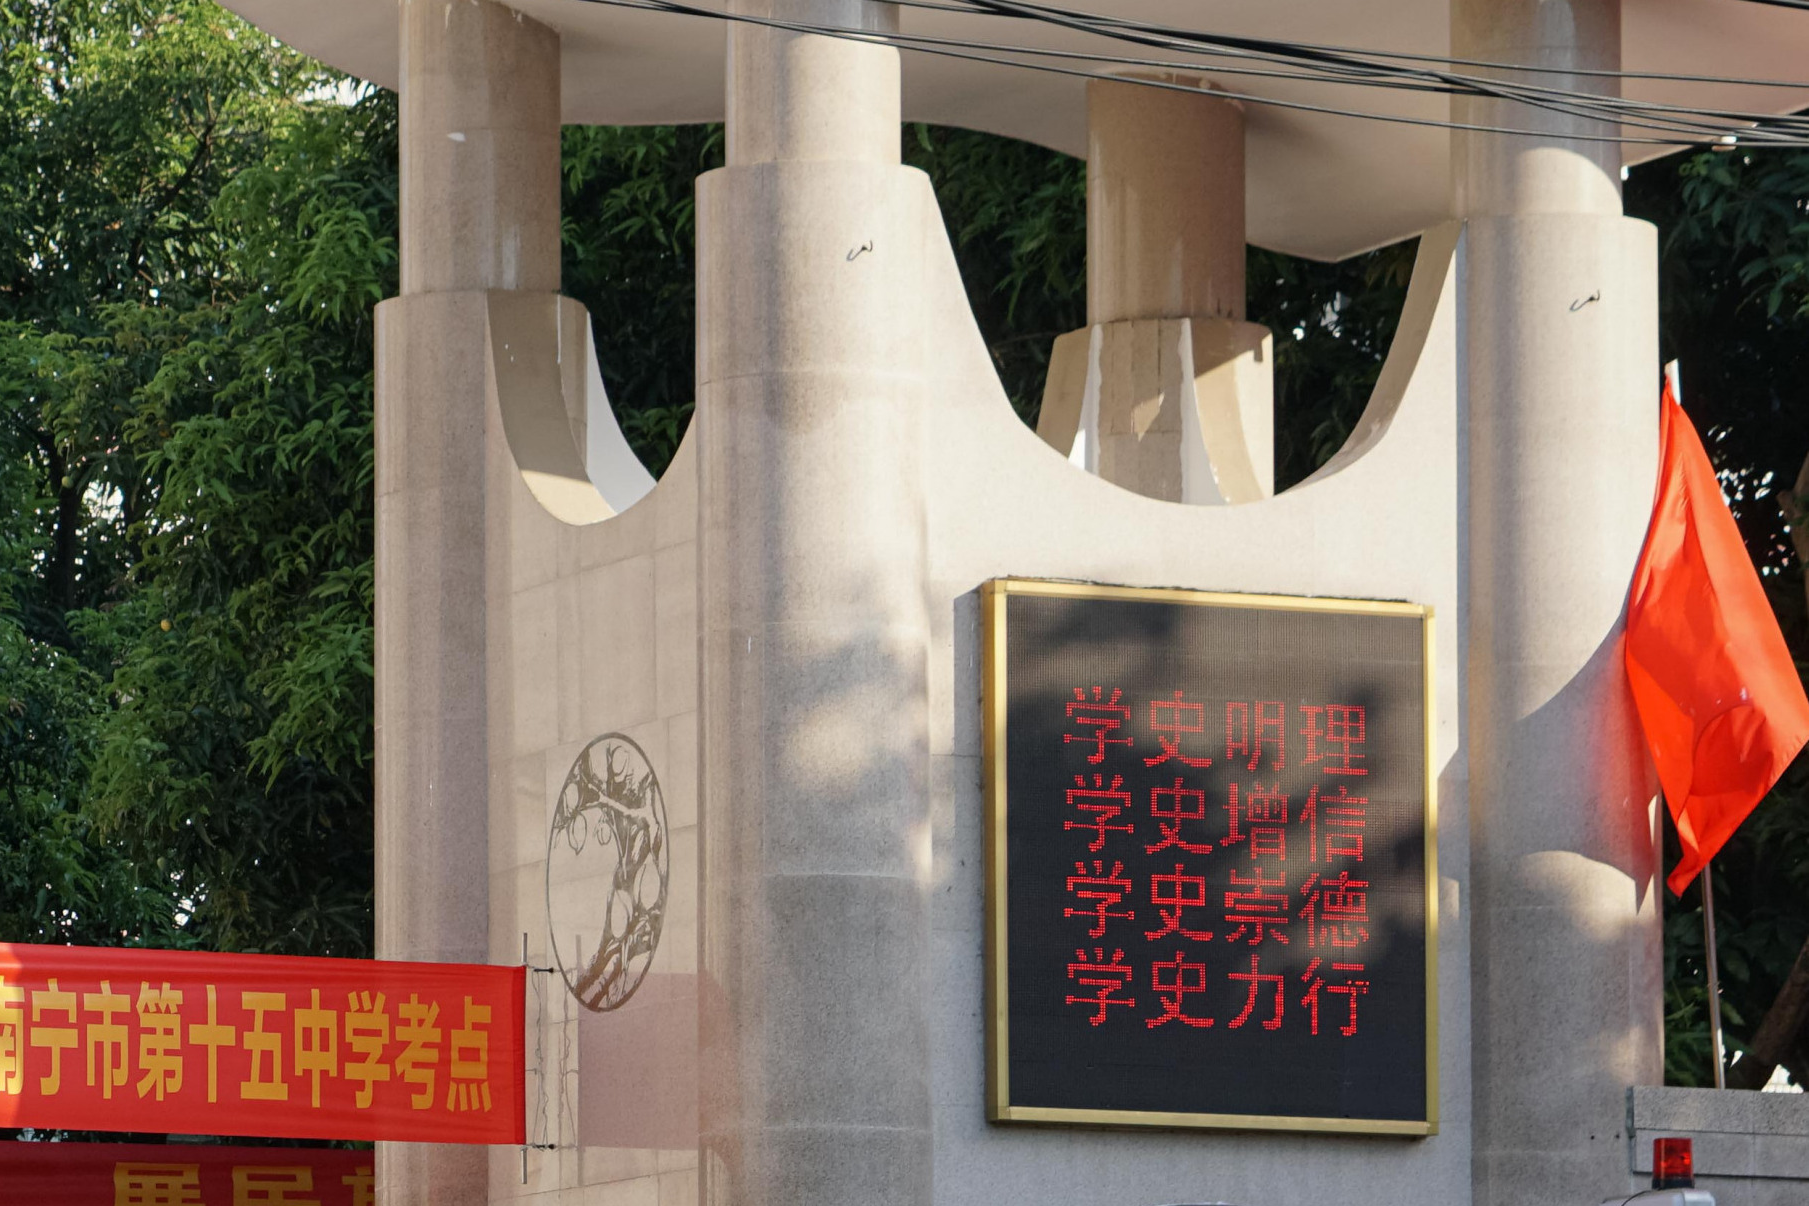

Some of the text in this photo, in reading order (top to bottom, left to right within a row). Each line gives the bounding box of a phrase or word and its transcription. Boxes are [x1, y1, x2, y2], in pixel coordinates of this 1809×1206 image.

[1063, 686, 1368, 776] 学史明理
[1063, 773, 1370, 863] 学史增信
[1063, 859, 1370, 949] 学史崇德
[1064, 947, 1370, 1036] 学史力行
